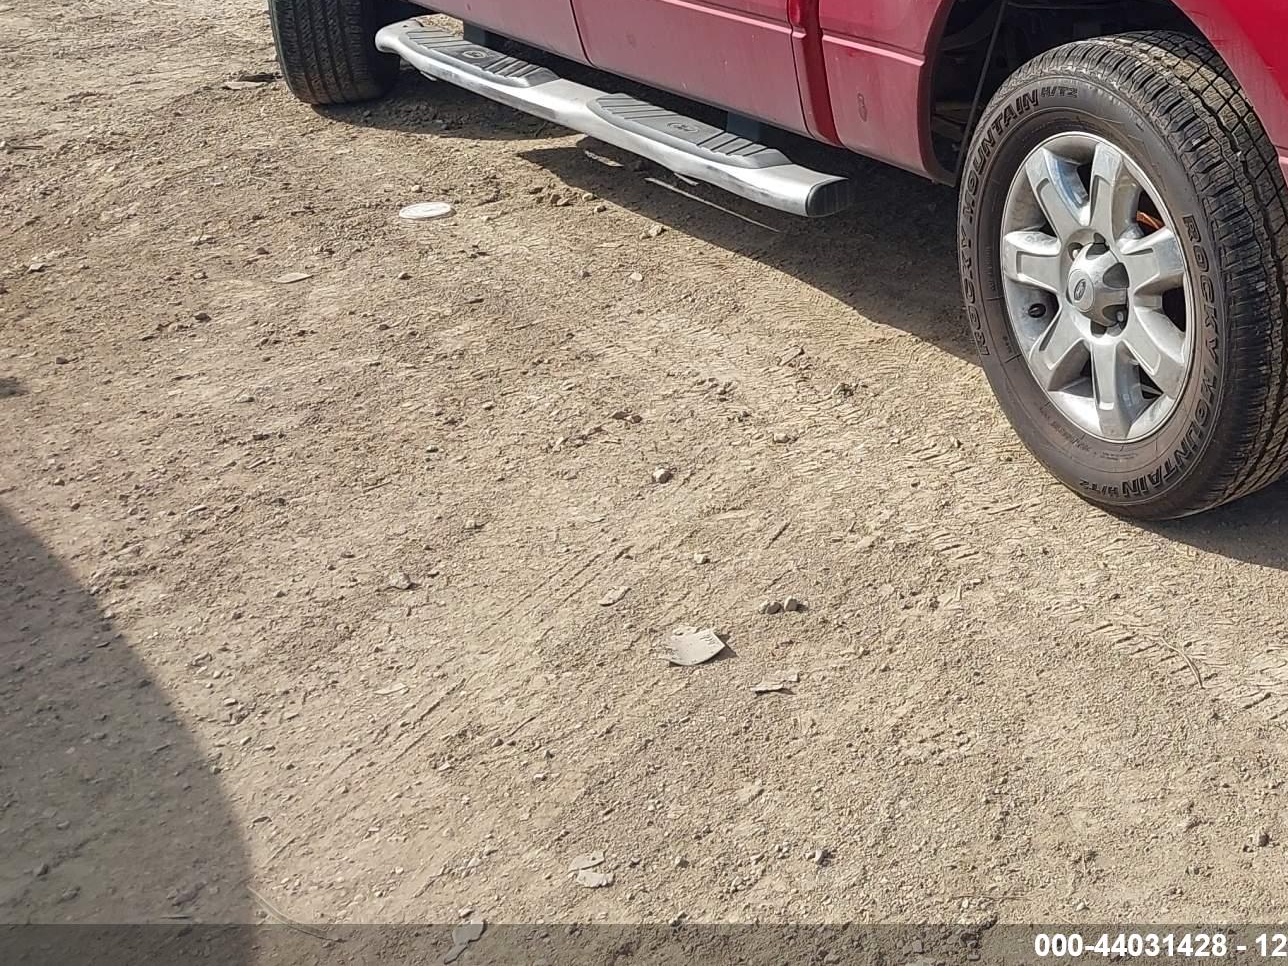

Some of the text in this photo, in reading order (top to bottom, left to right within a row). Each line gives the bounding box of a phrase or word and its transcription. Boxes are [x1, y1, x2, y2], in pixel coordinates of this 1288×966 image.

[962, 88, 1040, 224] MOUNTAIN
[1182, 214, 1219, 366] ROCKY
[1121, 368, 1218, 498] MOUNTAIN
